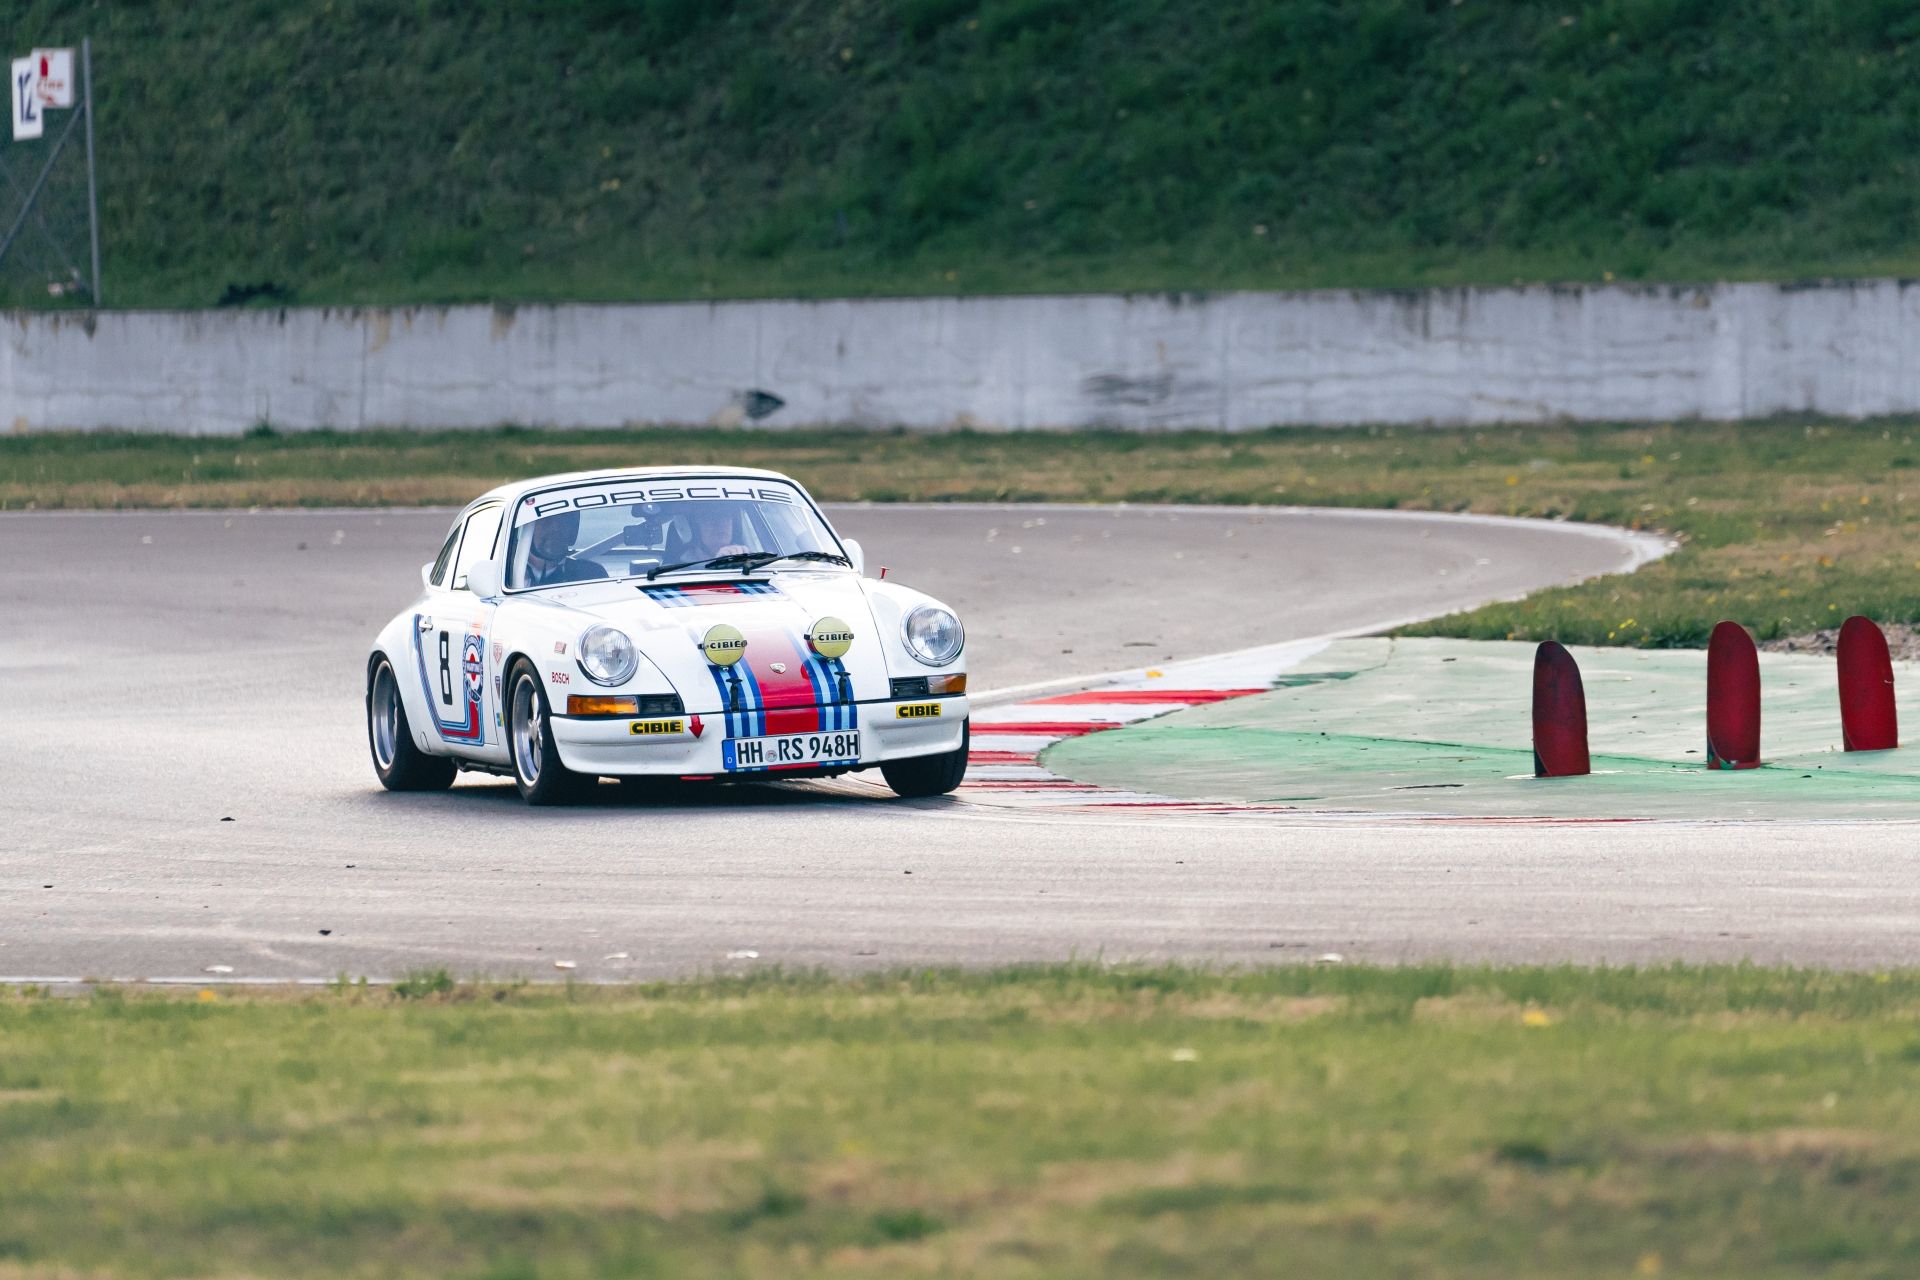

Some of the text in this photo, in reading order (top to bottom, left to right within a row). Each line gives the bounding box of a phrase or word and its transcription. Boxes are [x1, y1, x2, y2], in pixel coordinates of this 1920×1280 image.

[534, 487, 793, 518] PORSCHE
[439, 630, 453, 706] 8
[551, 671, 570, 685] BOSCH
[898, 705, 940, 717] CIBIE
[631, 721, 681, 733] CIBIE
[737, 741, 763, 764] HH
[778, 738, 804, 761] RS
[809, 734, 859, 759] 948H
